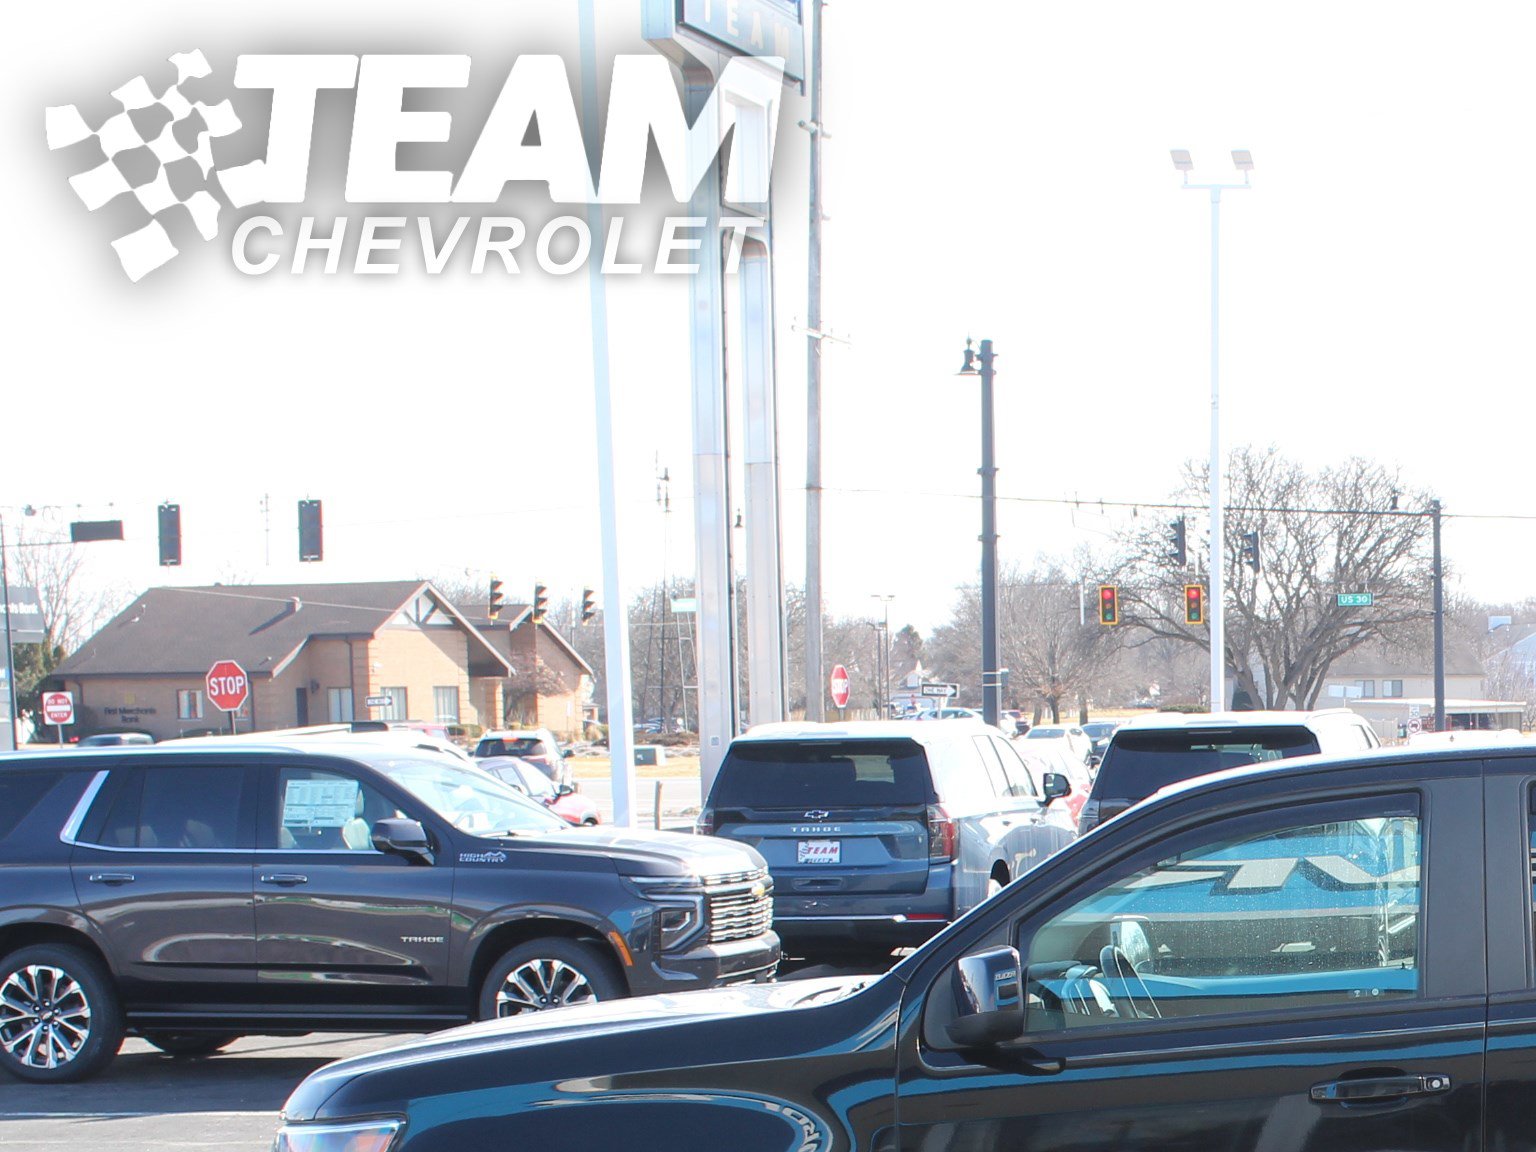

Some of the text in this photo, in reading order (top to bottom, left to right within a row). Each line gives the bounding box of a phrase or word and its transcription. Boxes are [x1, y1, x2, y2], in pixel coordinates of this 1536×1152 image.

[1341, 595, 1368, 603] US 30
[210, 675, 245, 696] STOP
[807, 846, 839, 855] TEAM
